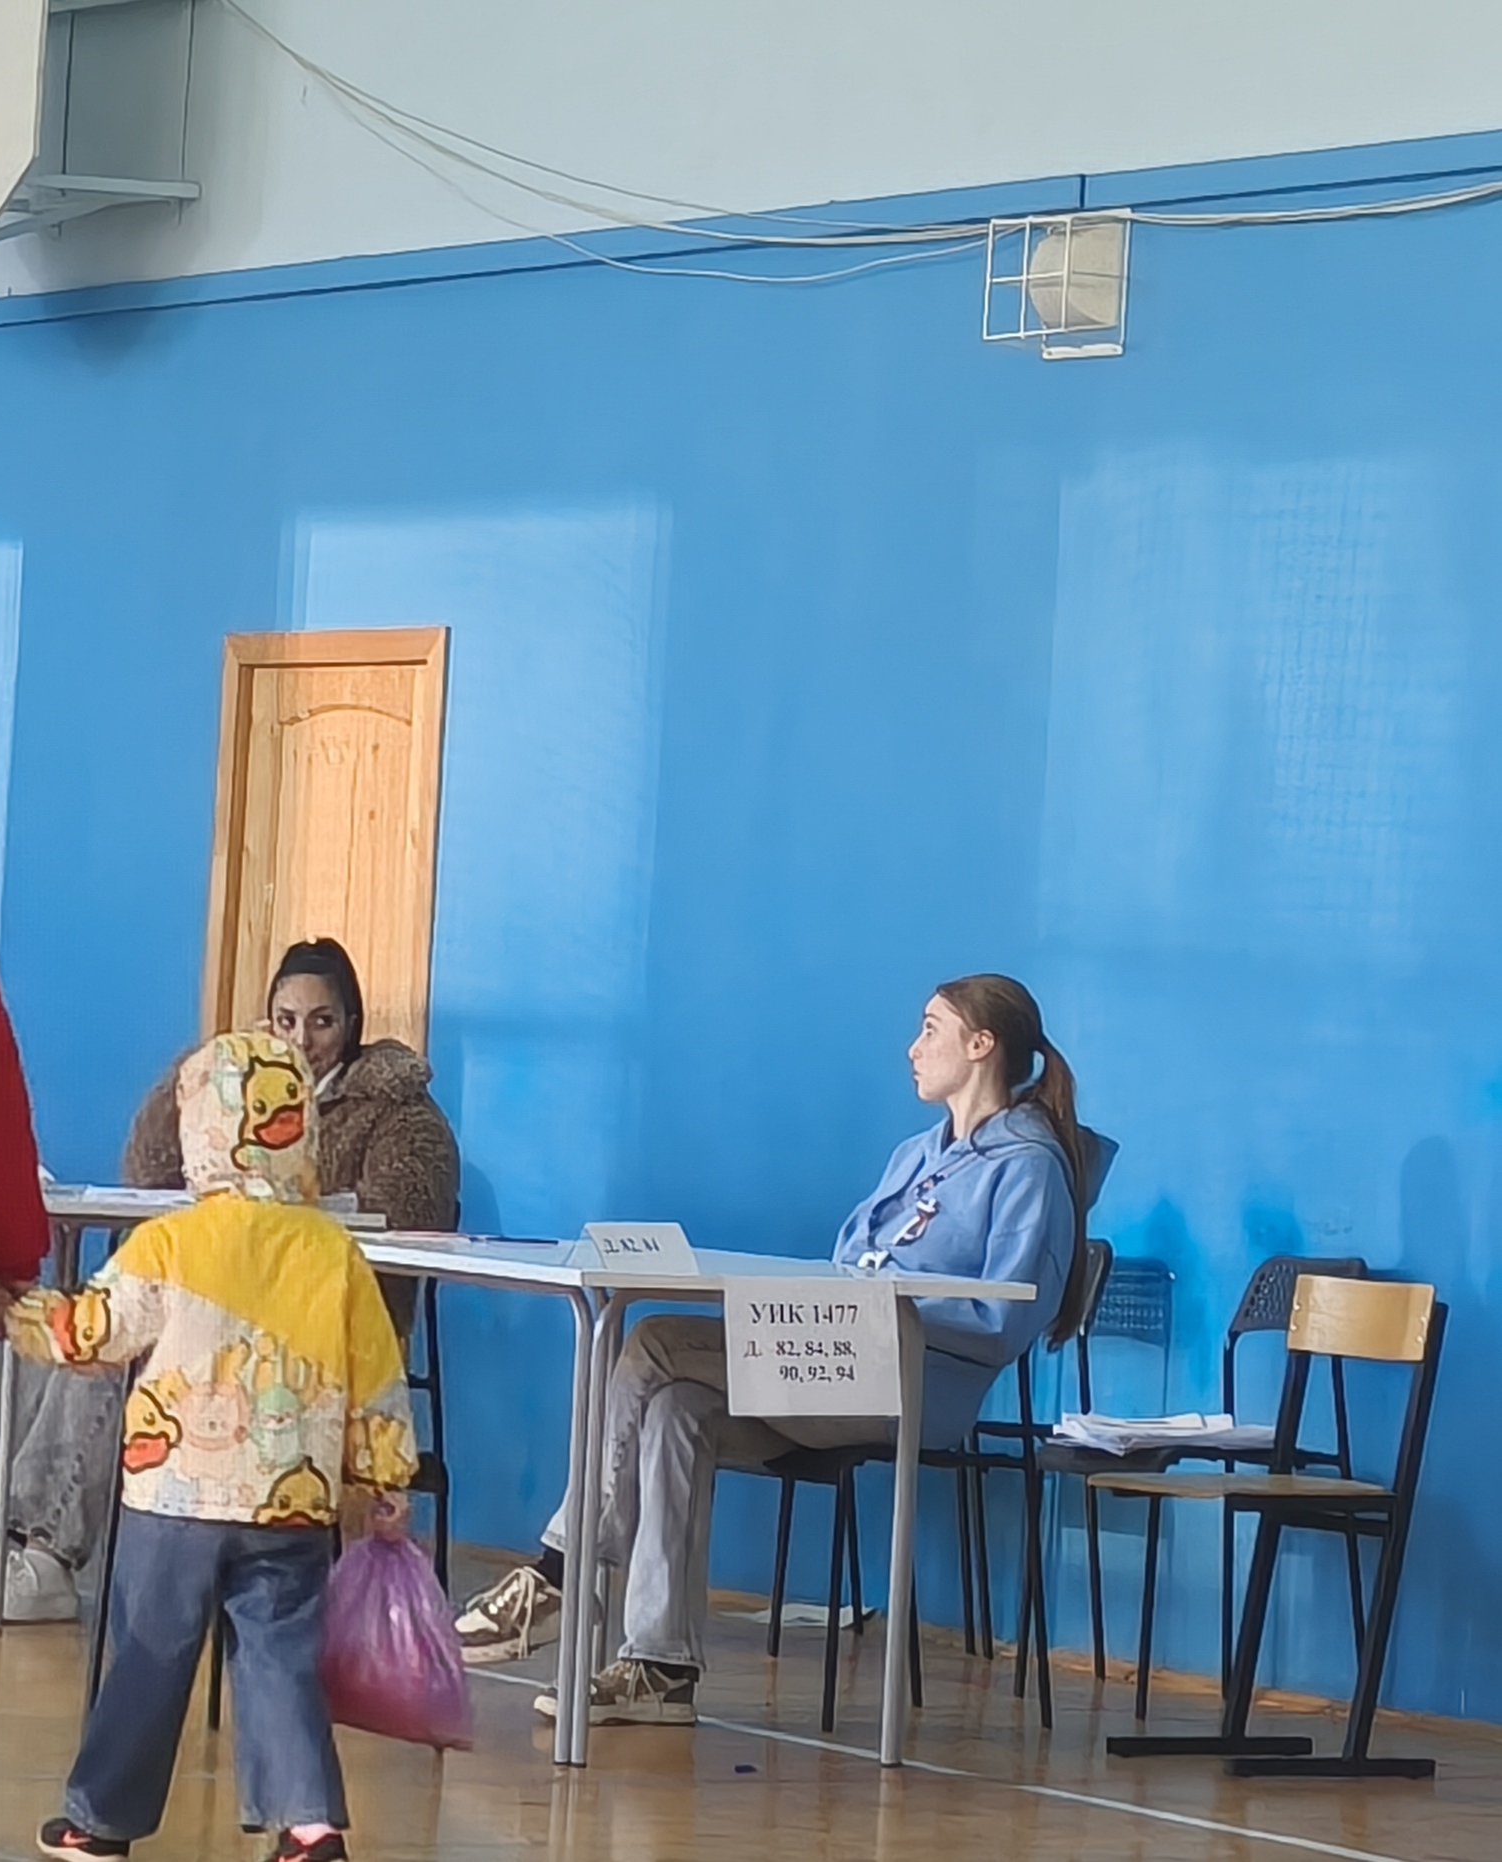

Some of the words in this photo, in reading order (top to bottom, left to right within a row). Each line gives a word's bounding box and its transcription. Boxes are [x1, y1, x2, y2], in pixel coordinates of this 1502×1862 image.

[751, 1304, 804, 1323] УИК
[813, 1304, 857, 1323] 1477
[780, 1366, 803, 1383] 90,
